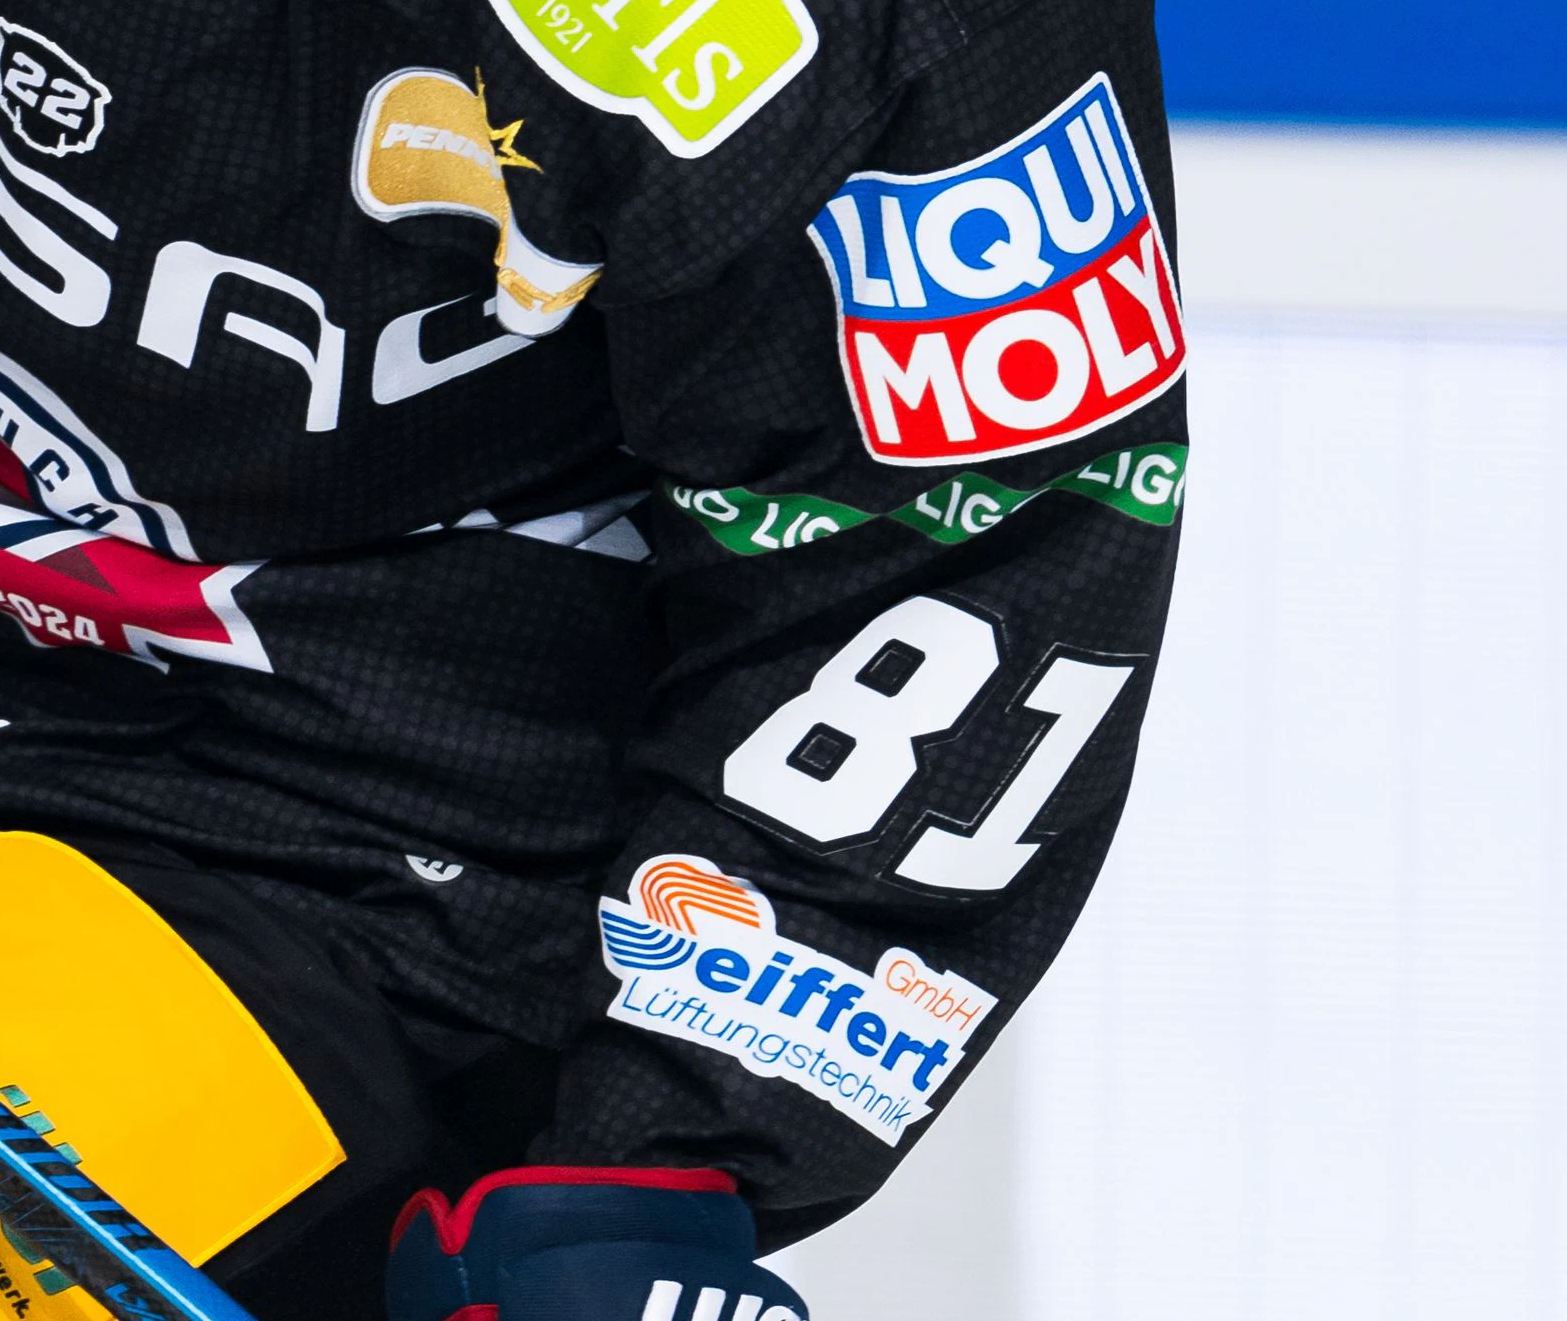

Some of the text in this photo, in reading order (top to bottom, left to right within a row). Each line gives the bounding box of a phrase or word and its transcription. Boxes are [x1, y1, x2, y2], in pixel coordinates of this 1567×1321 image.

[5, 50, 94, 130] 22
[826, 99, 1136, 309] LIQUI
[854, 227, 1176, 444] MOLY
[723, 595, 1135, 891] 81
[622, 977, 913, 1133] Lüftungstechnik
[885, 959, 982, 1032] GmbH
